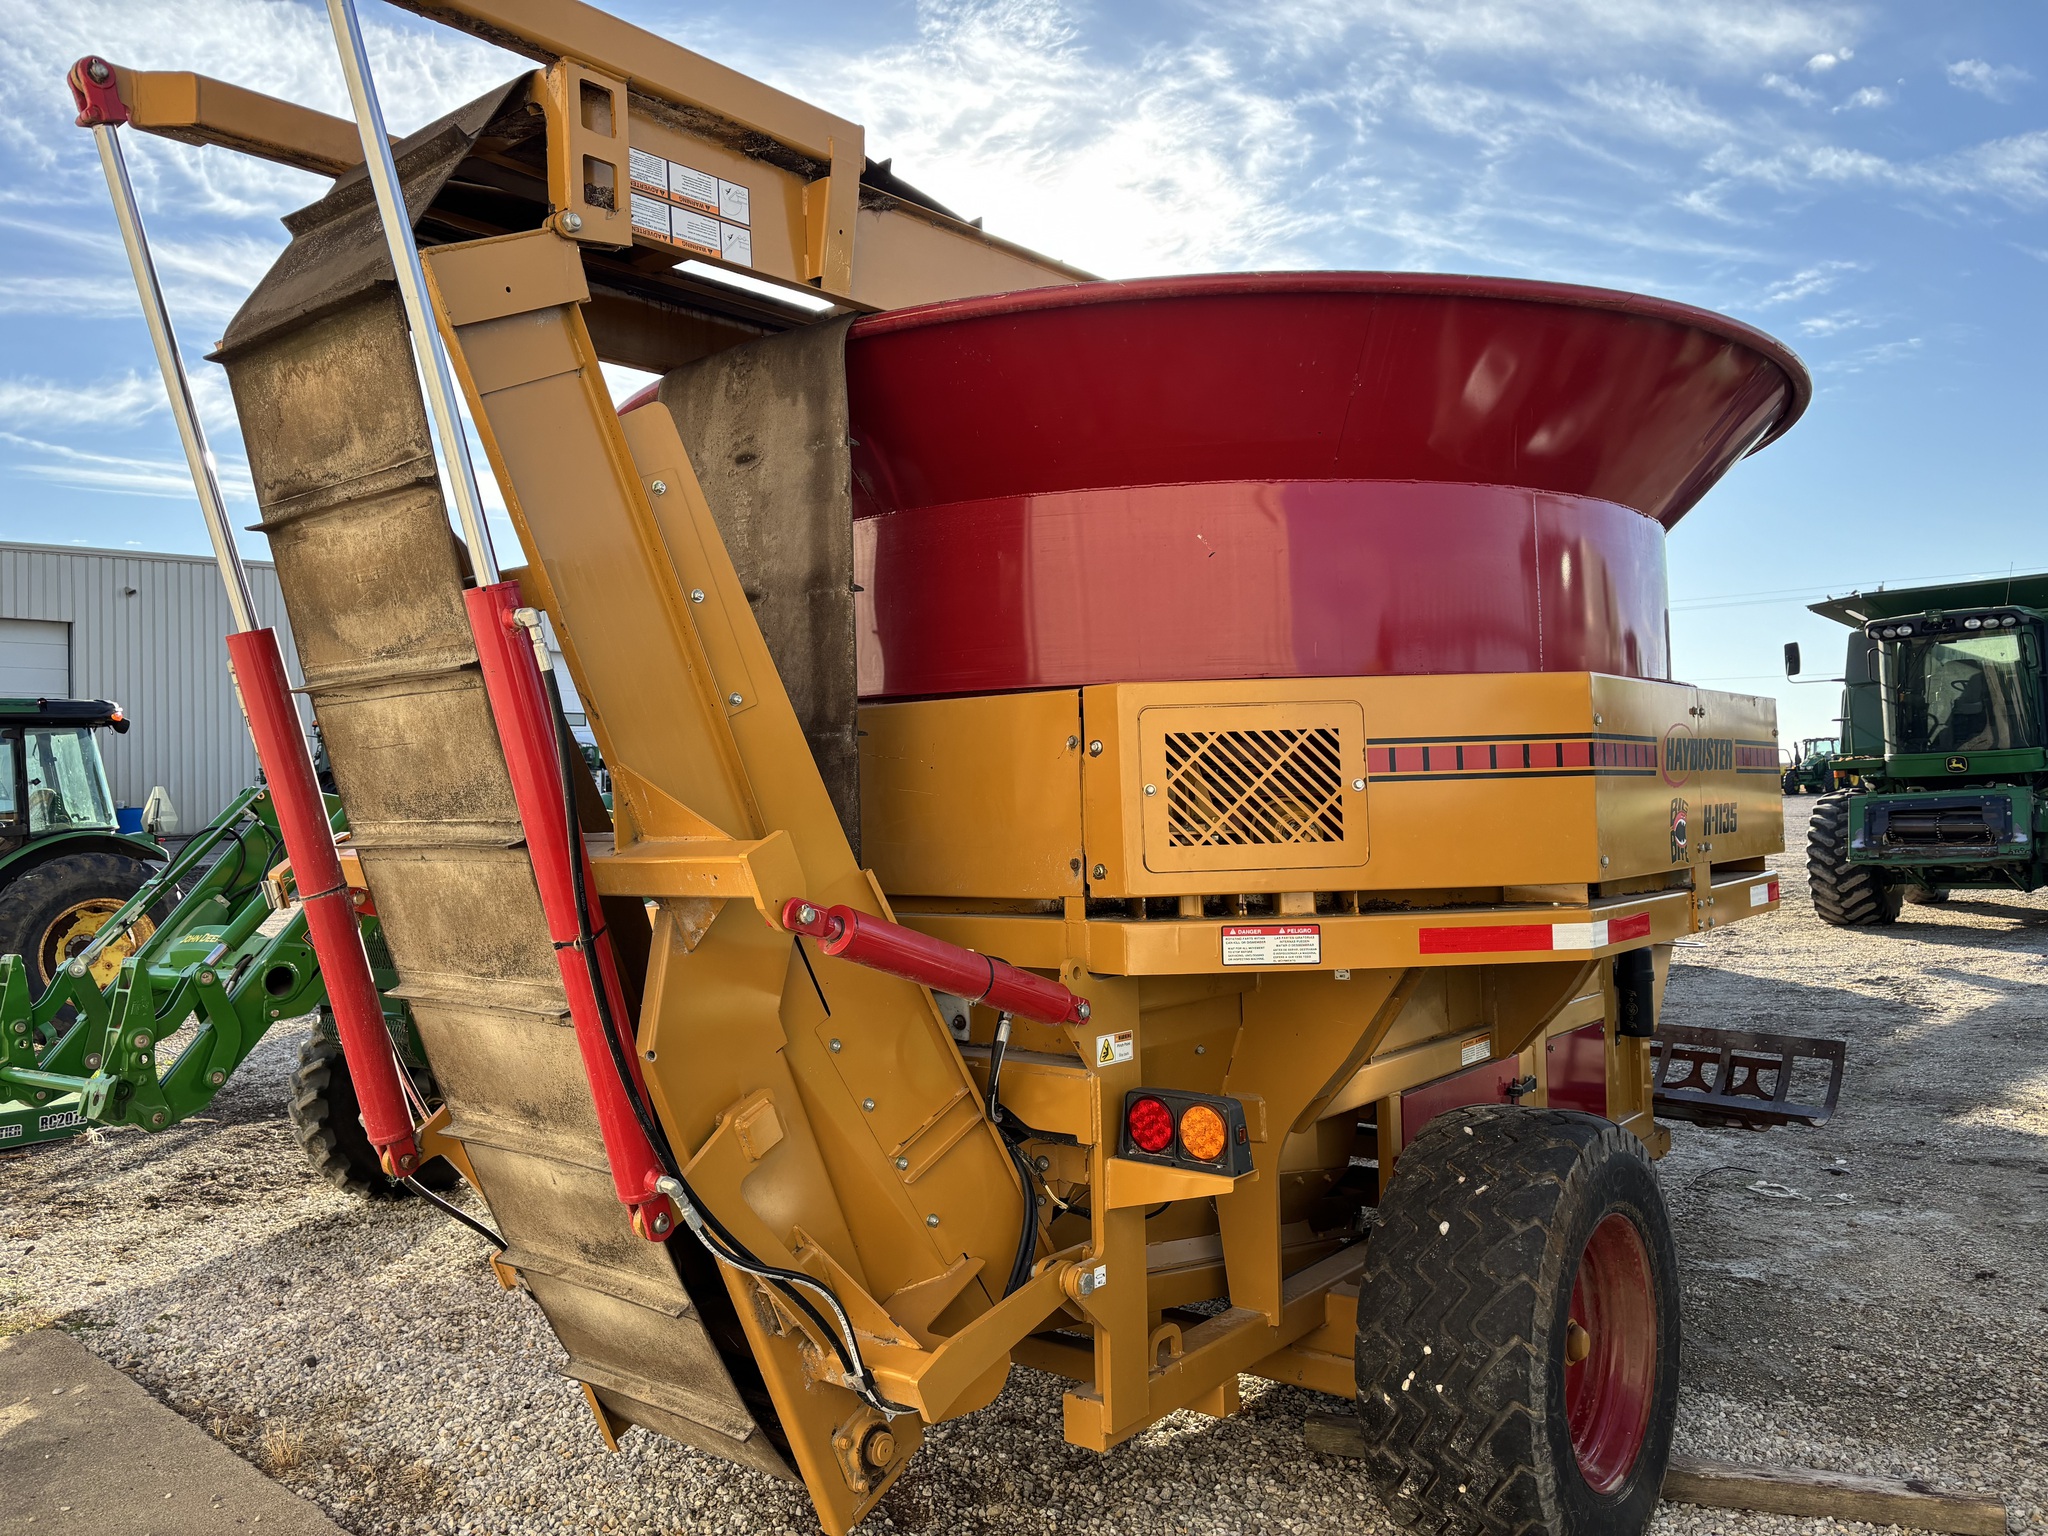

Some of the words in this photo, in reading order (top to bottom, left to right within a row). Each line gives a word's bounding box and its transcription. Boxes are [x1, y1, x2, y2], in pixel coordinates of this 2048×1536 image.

[679, 196, 704, 208] WARNING
[682, 241, 707, 252] WARNING
[1666, 738, 1732, 771] HAYBUSTER
[1704, 802, 1737, 836] H-1135
